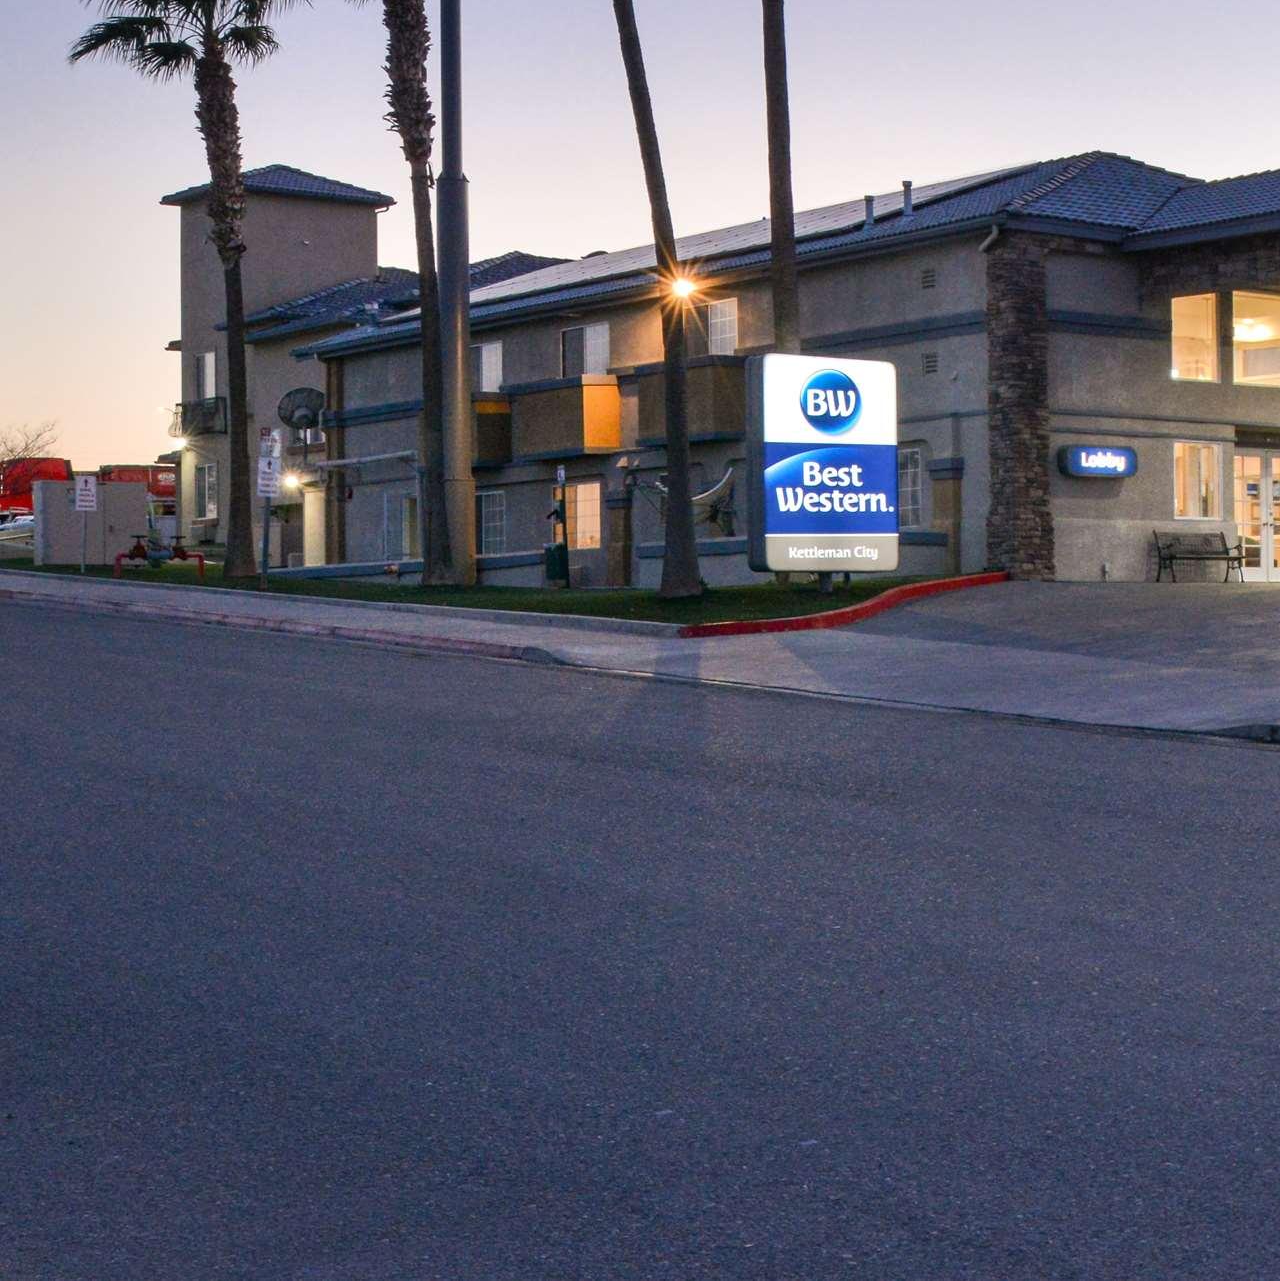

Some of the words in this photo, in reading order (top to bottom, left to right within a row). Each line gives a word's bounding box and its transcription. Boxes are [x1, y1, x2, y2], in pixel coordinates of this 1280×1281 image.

[806, 388, 856, 418] BW
[1081, 452, 1126, 472] Lobby
[802, 461, 864, 487] Best
[788, 546, 852, 559] Kettleman
[854, 546, 879, 561] City
